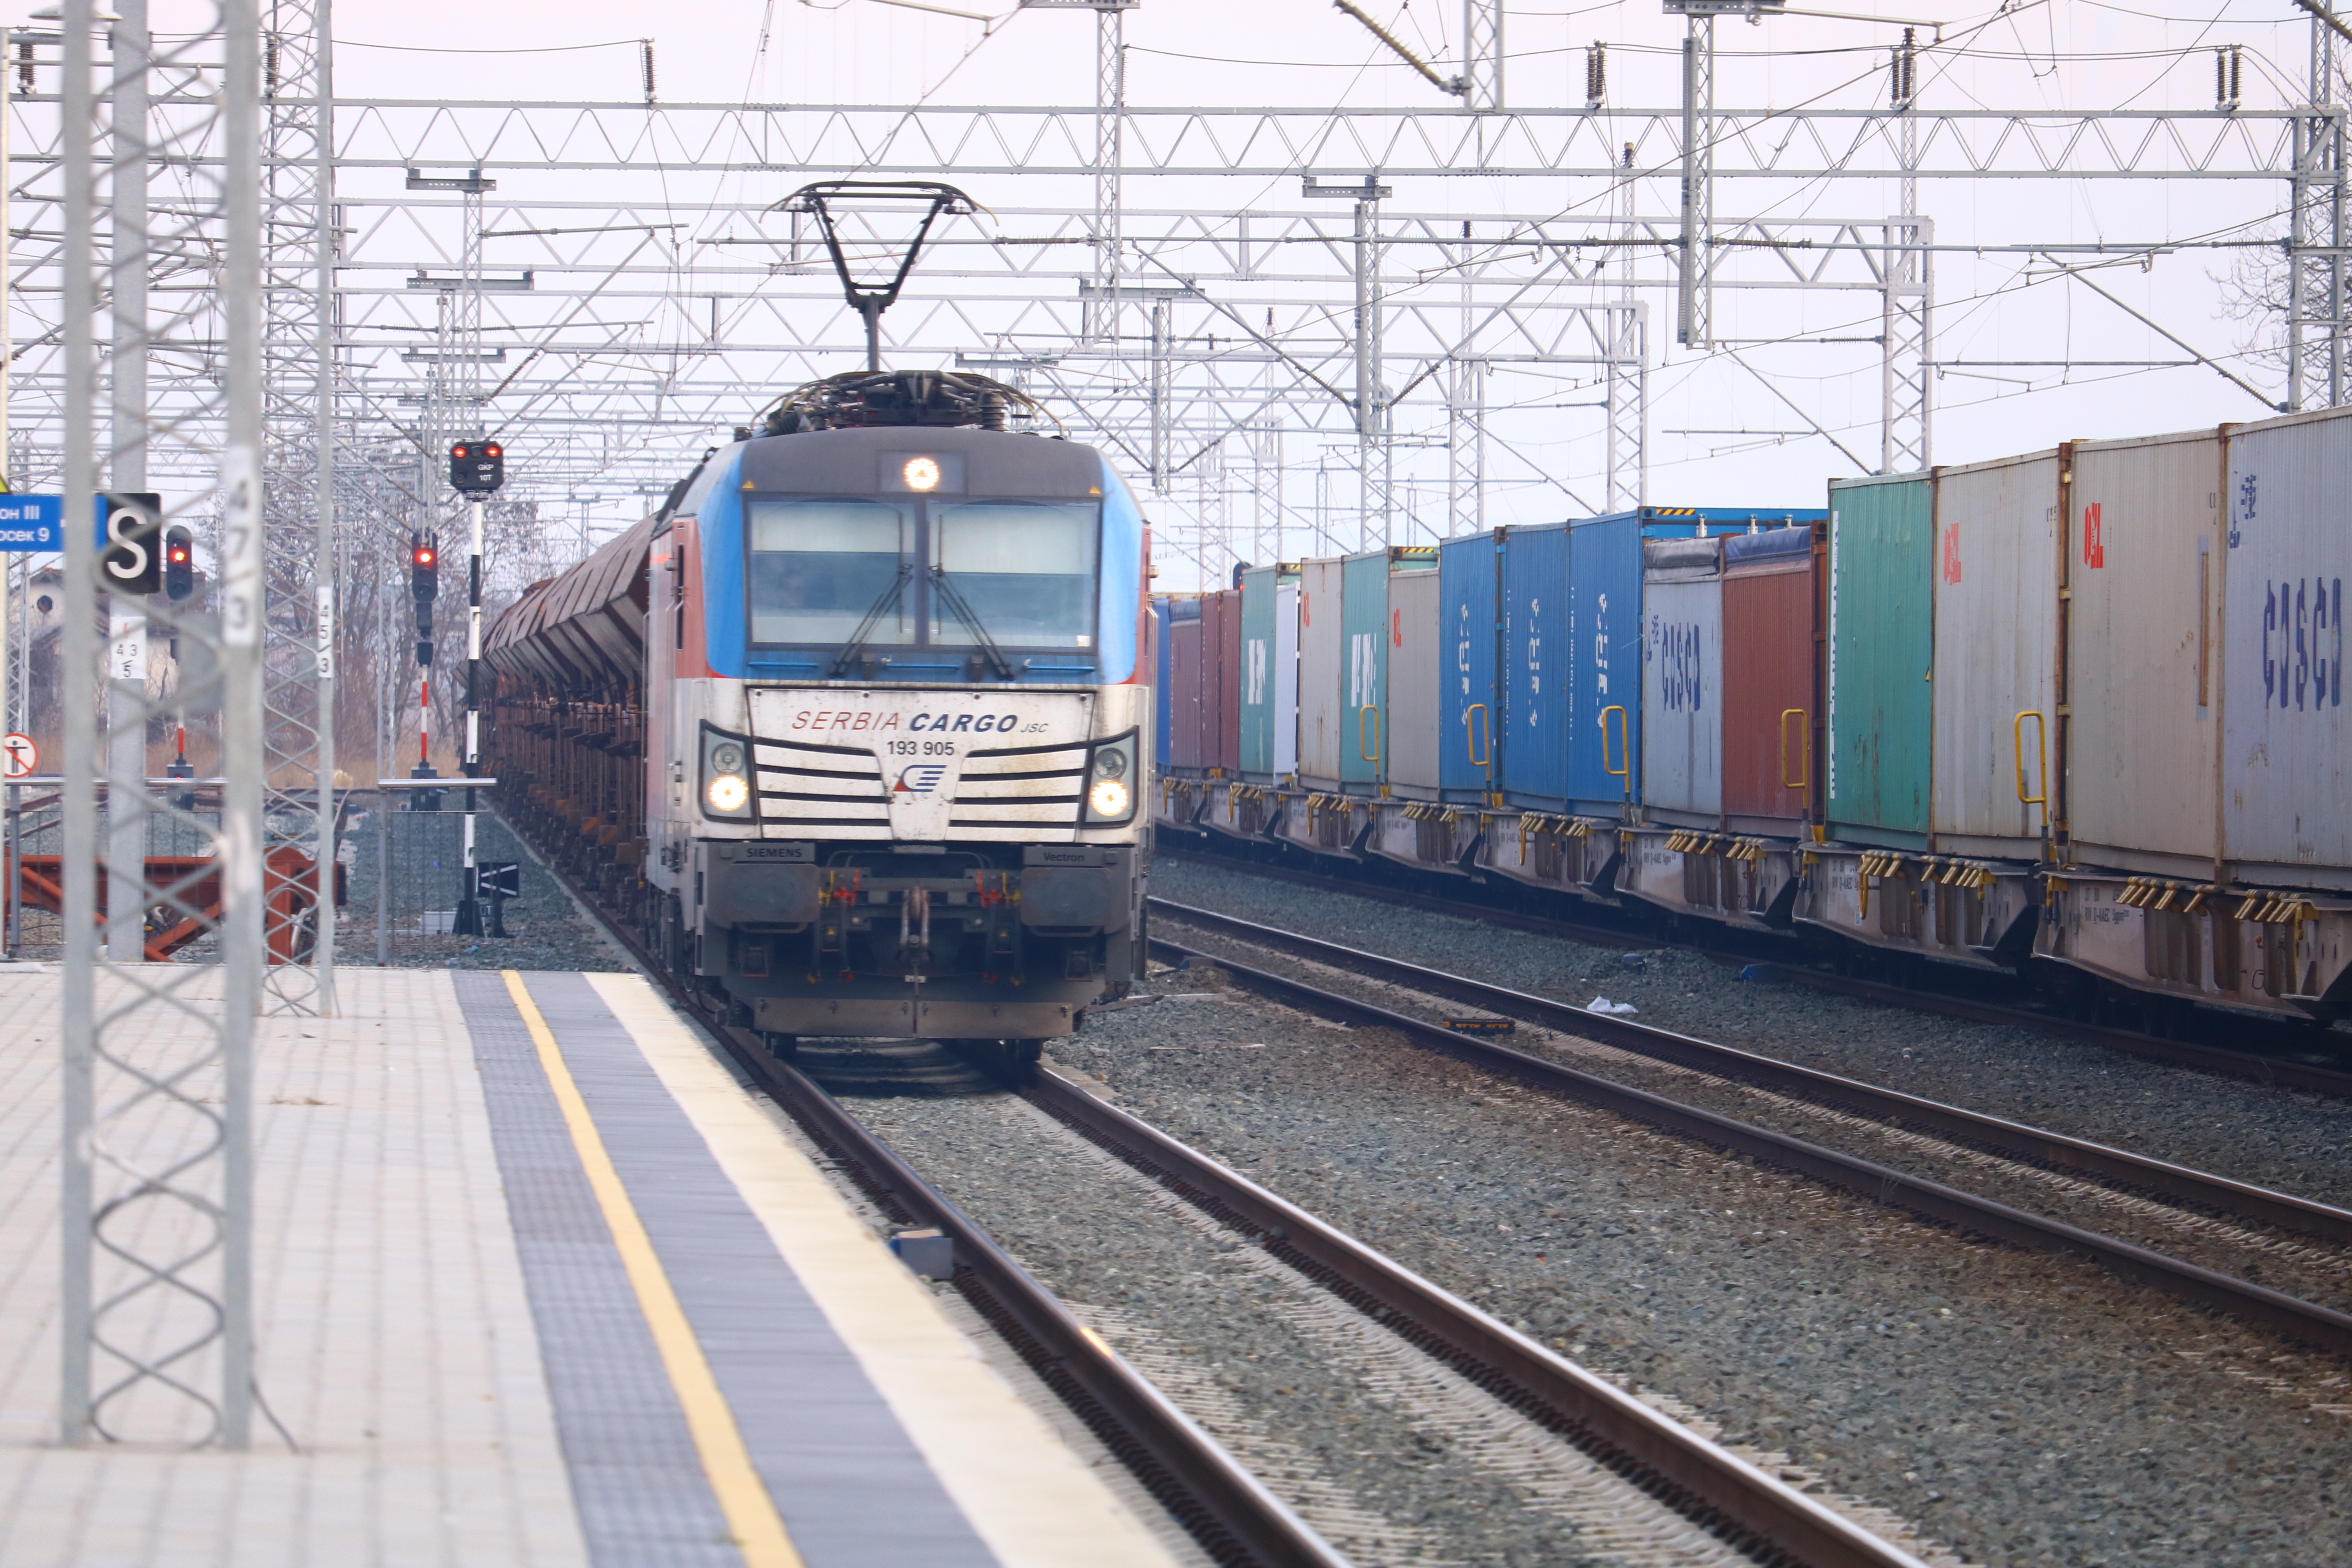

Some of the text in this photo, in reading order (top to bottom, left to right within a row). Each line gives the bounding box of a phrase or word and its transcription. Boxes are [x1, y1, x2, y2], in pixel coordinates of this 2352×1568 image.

[38, 527, 50, 541] 9
[107, 507, 147, 579] S
[2263, 577, 2341, 711] COSCO
[1662, 622, 1700, 713] COSCO
[792, 711, 1048, 733] SERBIA CARGO JSC
[887, 740, 955, 756] 193 905
[746, 848, 802, 858] SIEMENS
[1043, 852, 1084, 862] Vectron
